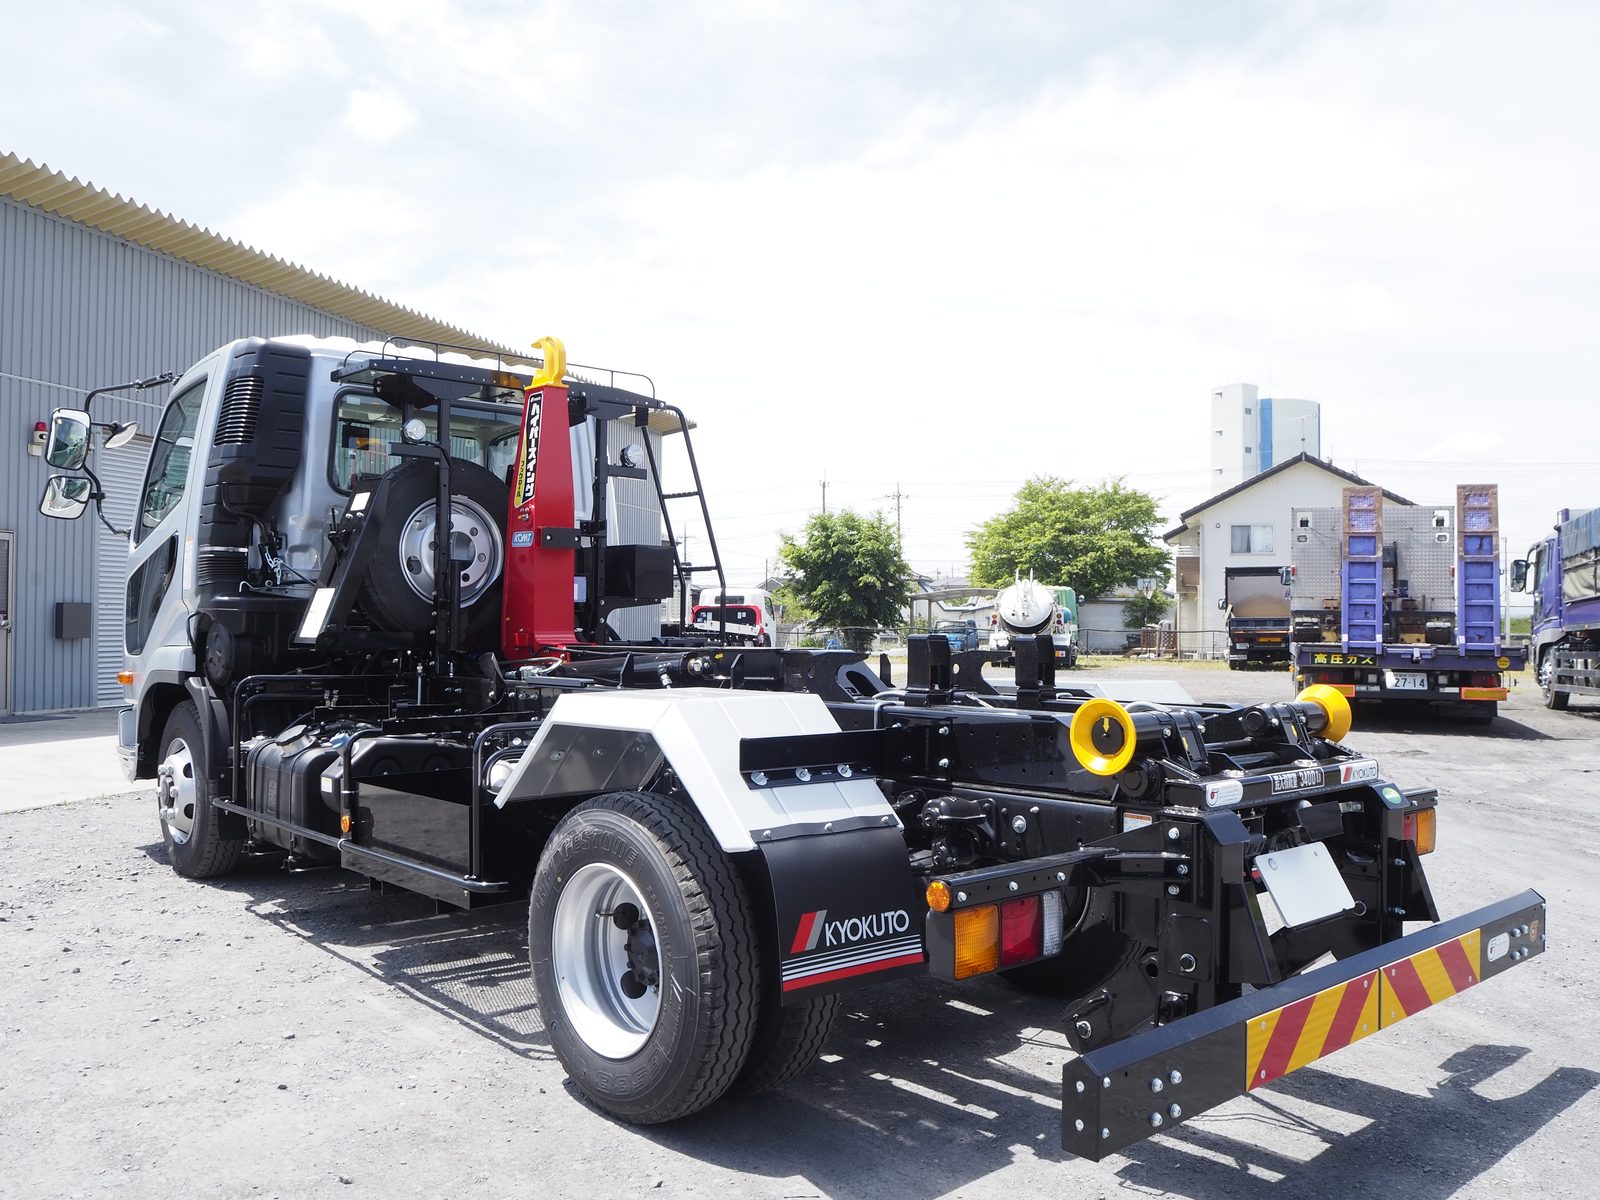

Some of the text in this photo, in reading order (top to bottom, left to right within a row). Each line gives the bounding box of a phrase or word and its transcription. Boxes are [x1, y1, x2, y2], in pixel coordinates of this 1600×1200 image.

[525, 403, 540, 497] ハイパースイング
[1352, 766, 1377, 780] KYOKUTO
[825, 909, 910, 947] KYOKUTO
